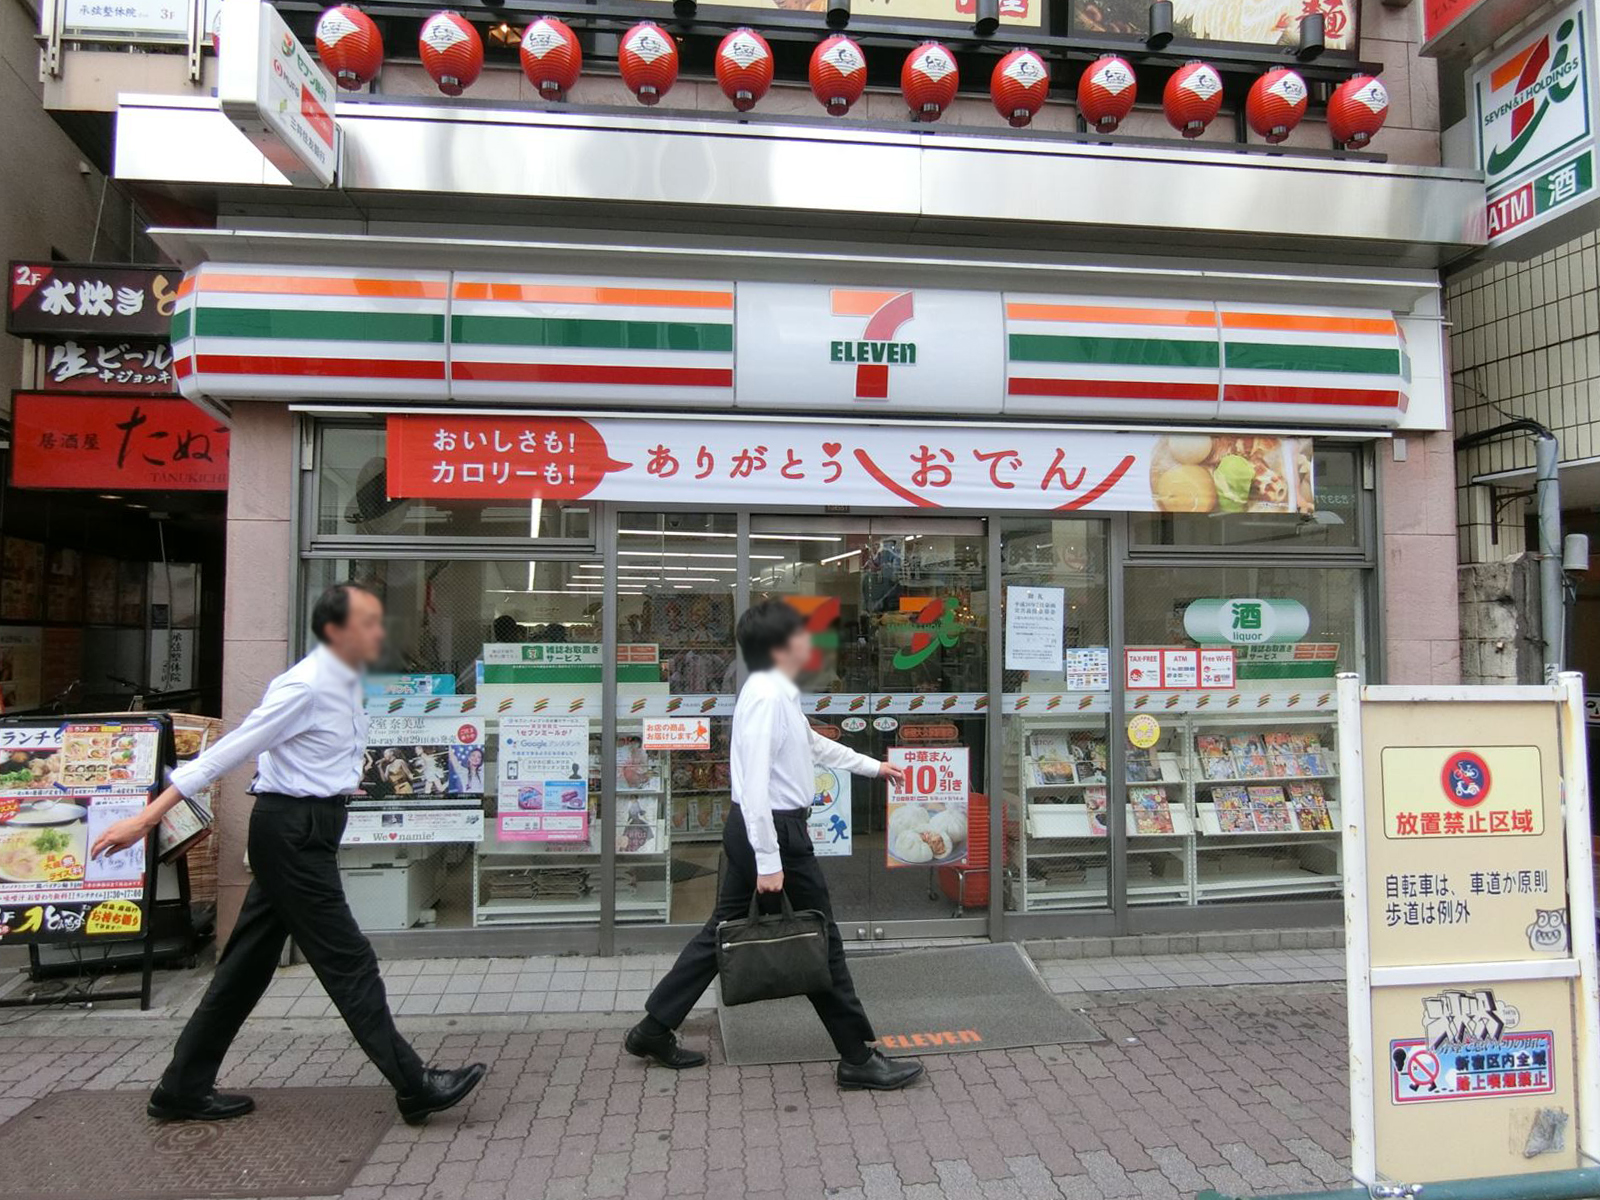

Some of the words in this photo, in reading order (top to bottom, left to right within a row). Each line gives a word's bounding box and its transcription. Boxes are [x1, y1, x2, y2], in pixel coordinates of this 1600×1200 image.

[1525, 57, 1579, 99] HOLDINGS
[1549, 162, 1577, 206] 酒
[1487, 188, 1528, 235] ATM
[16, 266, 42, 286] 2F
[40, 279, 145, 317] 水炊き
[47, 340, 173, 382] 生ビール
[40, 432, 100, 450] 居酒屋
[115, 406, 231, 470] たぬ
[646, 444, 843, 484] ありがとう
[909, 444, 1088, 491] おでん
[1232, 603, 1262, 630] 酒
[1232, 631, 1263, 642] liquor
[546, 645, 599, 655] 雑誌お取置き
[1129, 655, 1157, 663] TAX-FREE
[367, 736, 395, 746] lu-ray
[520, 740, 547, 749] Google
[904, 751, 953, 762] 中華まん
[940, 779, 963, 792] 引き
[1396, 809, 1534, 836] 放置禁止区域
[91, 910, 139, 926] お持ち帰り
[1385, 899, 1471, 927] 歩道は例外
[1455, 1050, 1547, 1071] 新宿区内全域
[1456, 1071, 1547, 1092] 路上喫煙禁止
